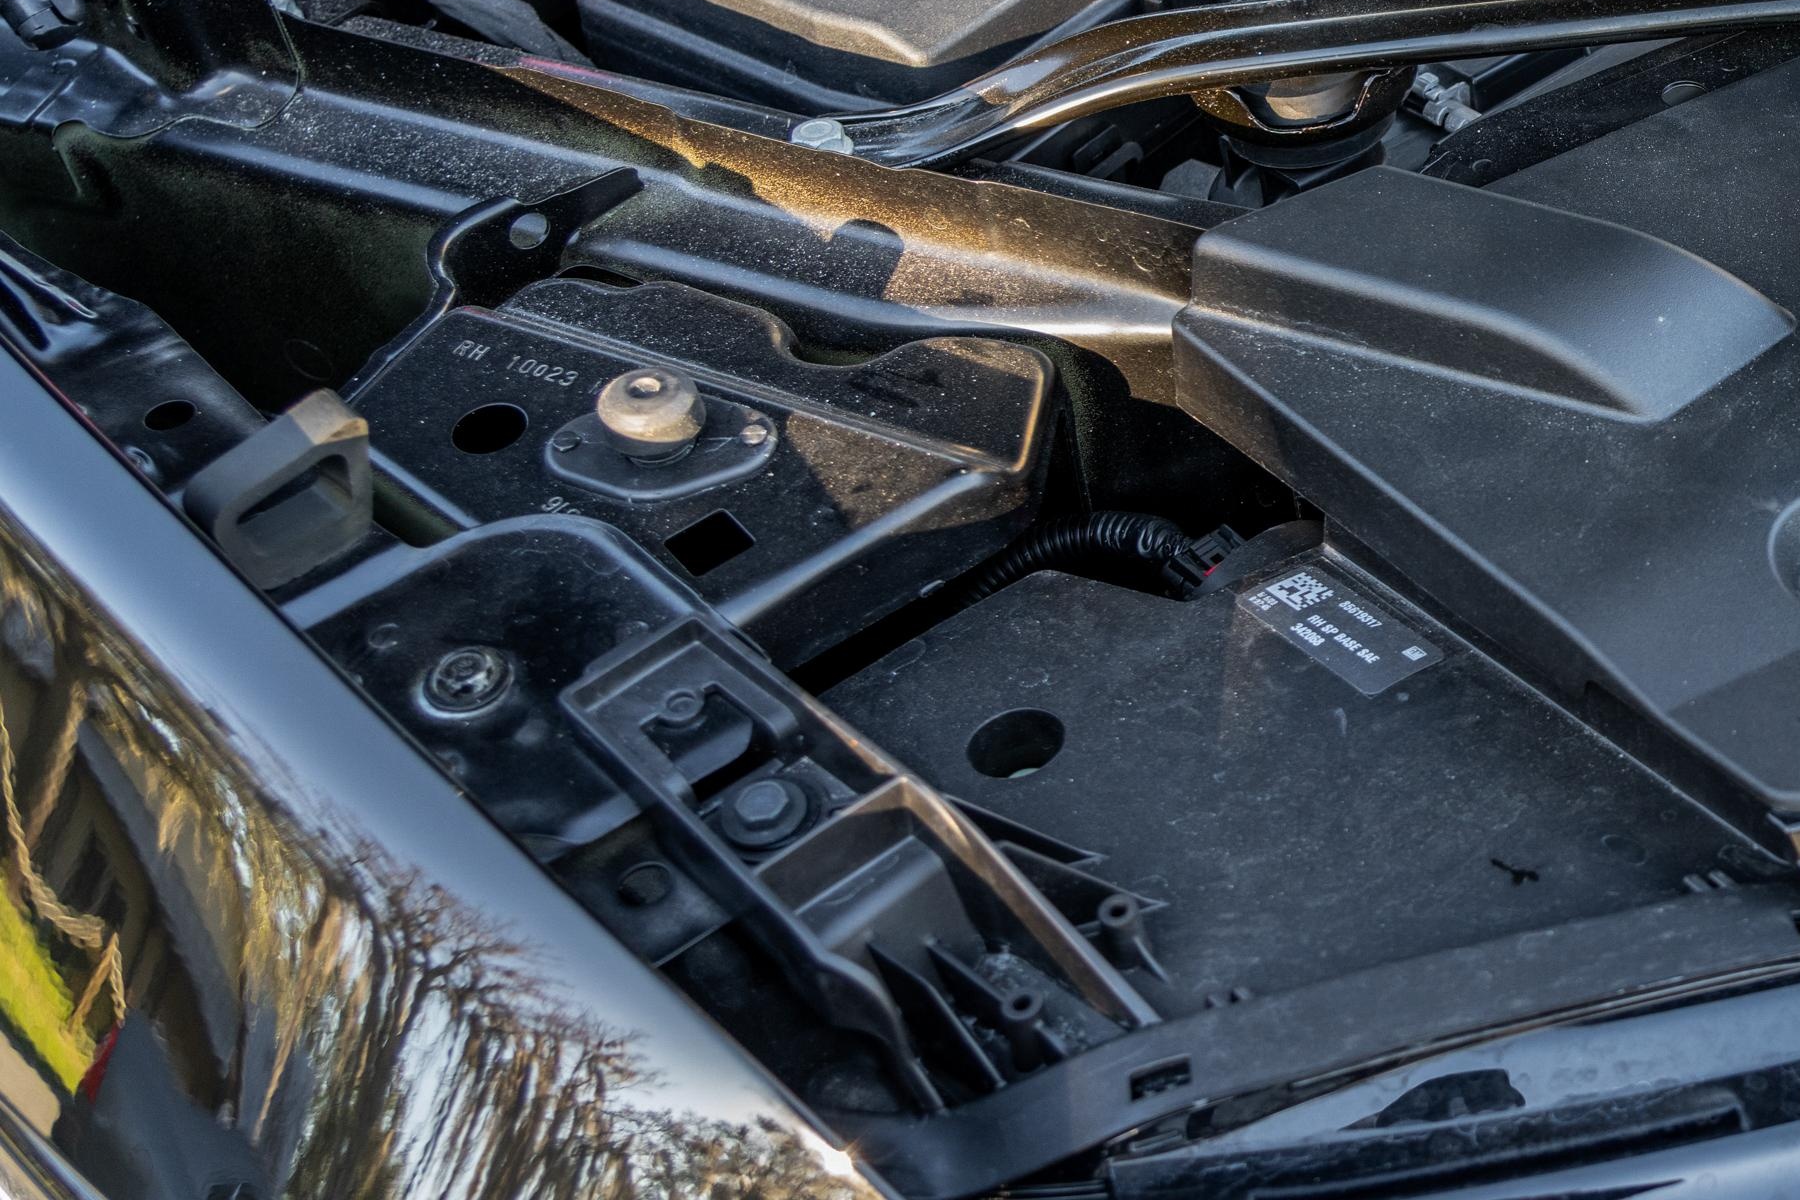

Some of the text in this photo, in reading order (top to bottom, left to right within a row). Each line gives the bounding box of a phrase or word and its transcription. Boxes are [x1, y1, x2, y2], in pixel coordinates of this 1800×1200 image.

[452, 340, 490, 360] RH
[506, 355, 579, 387] 10023
[1307, 614, 1381, 664] RH SP BASE SAE
